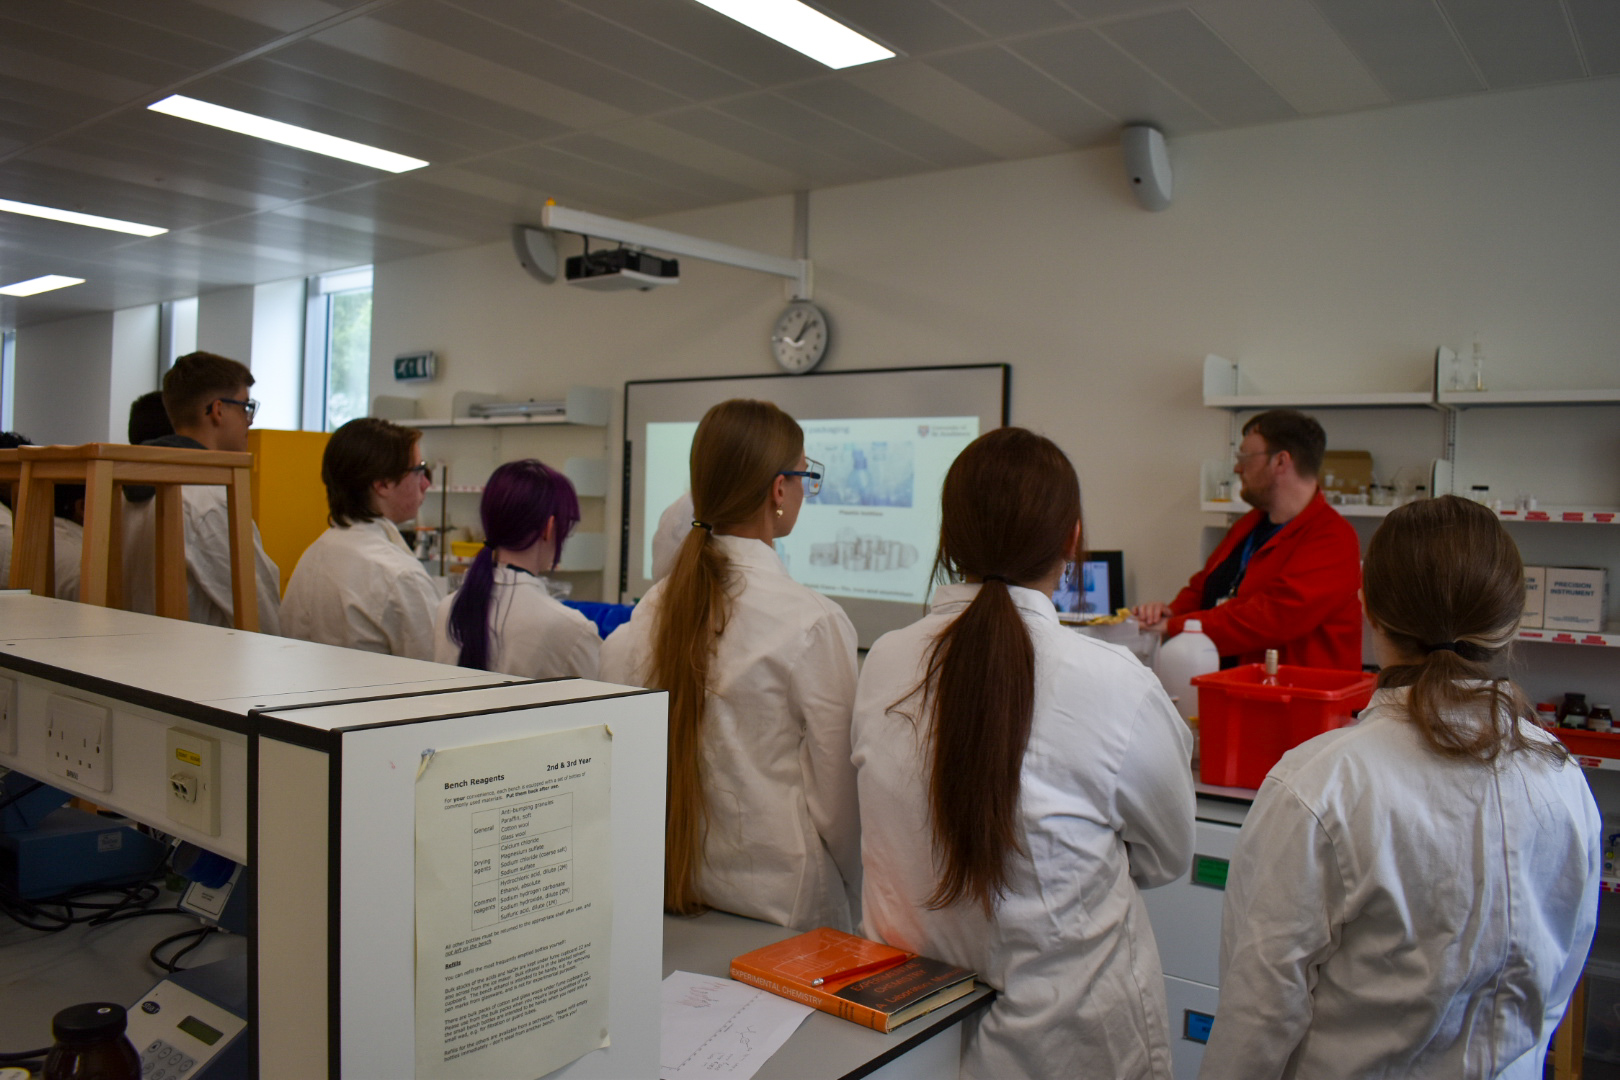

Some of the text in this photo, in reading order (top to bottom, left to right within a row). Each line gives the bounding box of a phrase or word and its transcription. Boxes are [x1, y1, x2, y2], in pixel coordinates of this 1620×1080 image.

[547, 763, 558, 771] 2nd
[444, 775, 505, 789] Bench Reagents
[501, 800, 554, 815] Anti-bumping granules
[474, 824, 494, 834] General
[500, 837, 539, 850] Calcium chloride
[500, 844, 544, 859] Magnesium sulfate
[474, 858, 490, 866] Drying
[500, 860, 518, 868] Sodium
[520, 854, 538, 863] chloride
[539, 850, 556, 860] (coarse
[474, 866, 491, 874] agents
[500, 863, 535, 876] Sodium sulfate
[500, 874, 529, 886] Hydrochloric
[558, 864, 568, 873] (2M)
[500, 880, 541, 894] Ethanol, absolute
[500, 881, 565, 903] Sodium hydrogen carbonate
[474, 897, 496, 907] Common
[500, 903, 518, 911] Sodium
[520, 896, 544, 907] hydroxide,
[559, 888, 570, 897] (2M)
[474, 904, 496, 914] reagents
[500, 910, 518, 920] Sulfuric
[546, 900, 557, 909] (1M)
[850, 962, 920, 992] EXPERIMENTAL
[731, 968, 823, 1005] EXPERIMENTAL CHEMISTRY
